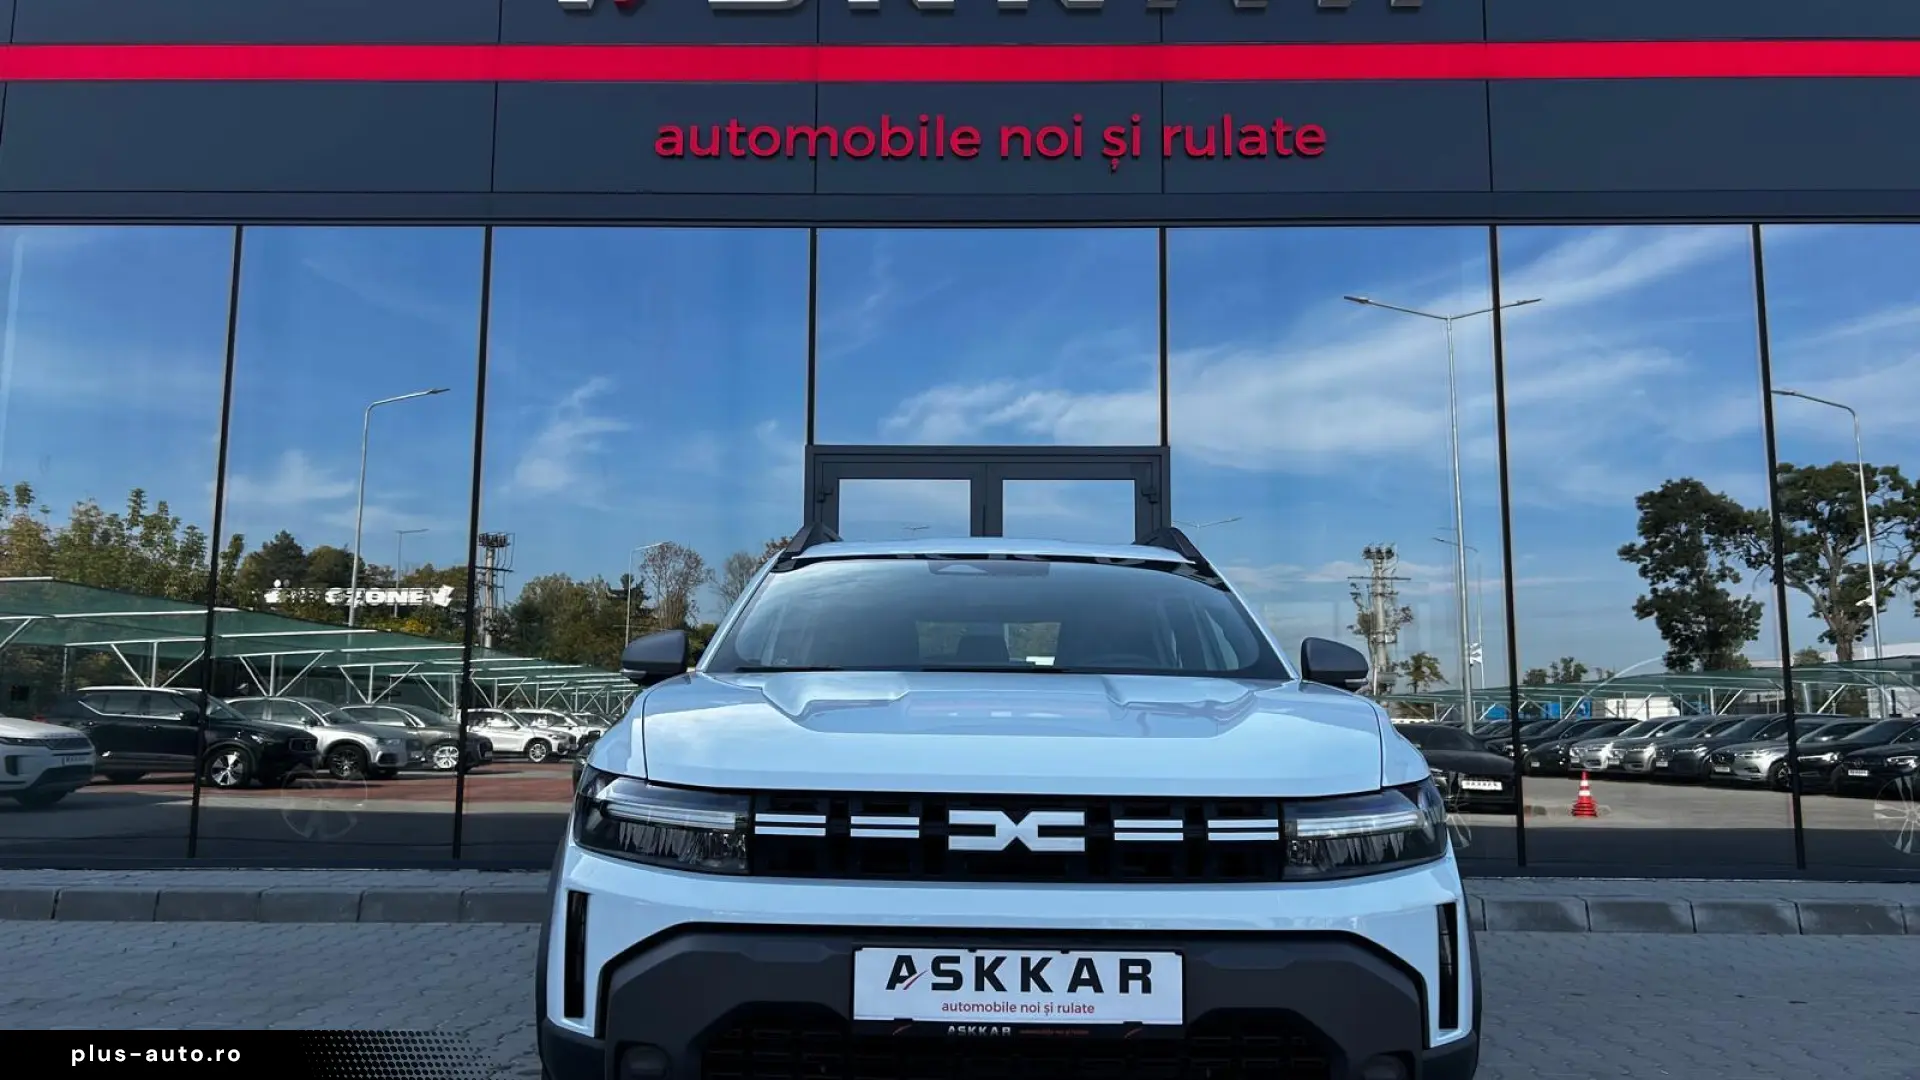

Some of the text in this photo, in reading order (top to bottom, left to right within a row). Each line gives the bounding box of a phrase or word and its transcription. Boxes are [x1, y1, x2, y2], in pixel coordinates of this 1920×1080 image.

[655, 114, 1326, 170] automobile noi și rulate
[886, 954, 1152, 995] ASKKAR
[941, 1001, 1017, 1014] automobile
[1020, 1002, 1041, 1014] noi
[1057, 1003, 1095, 1015] rulate
[948, 1025, 1012, 1037] ASKKAR
